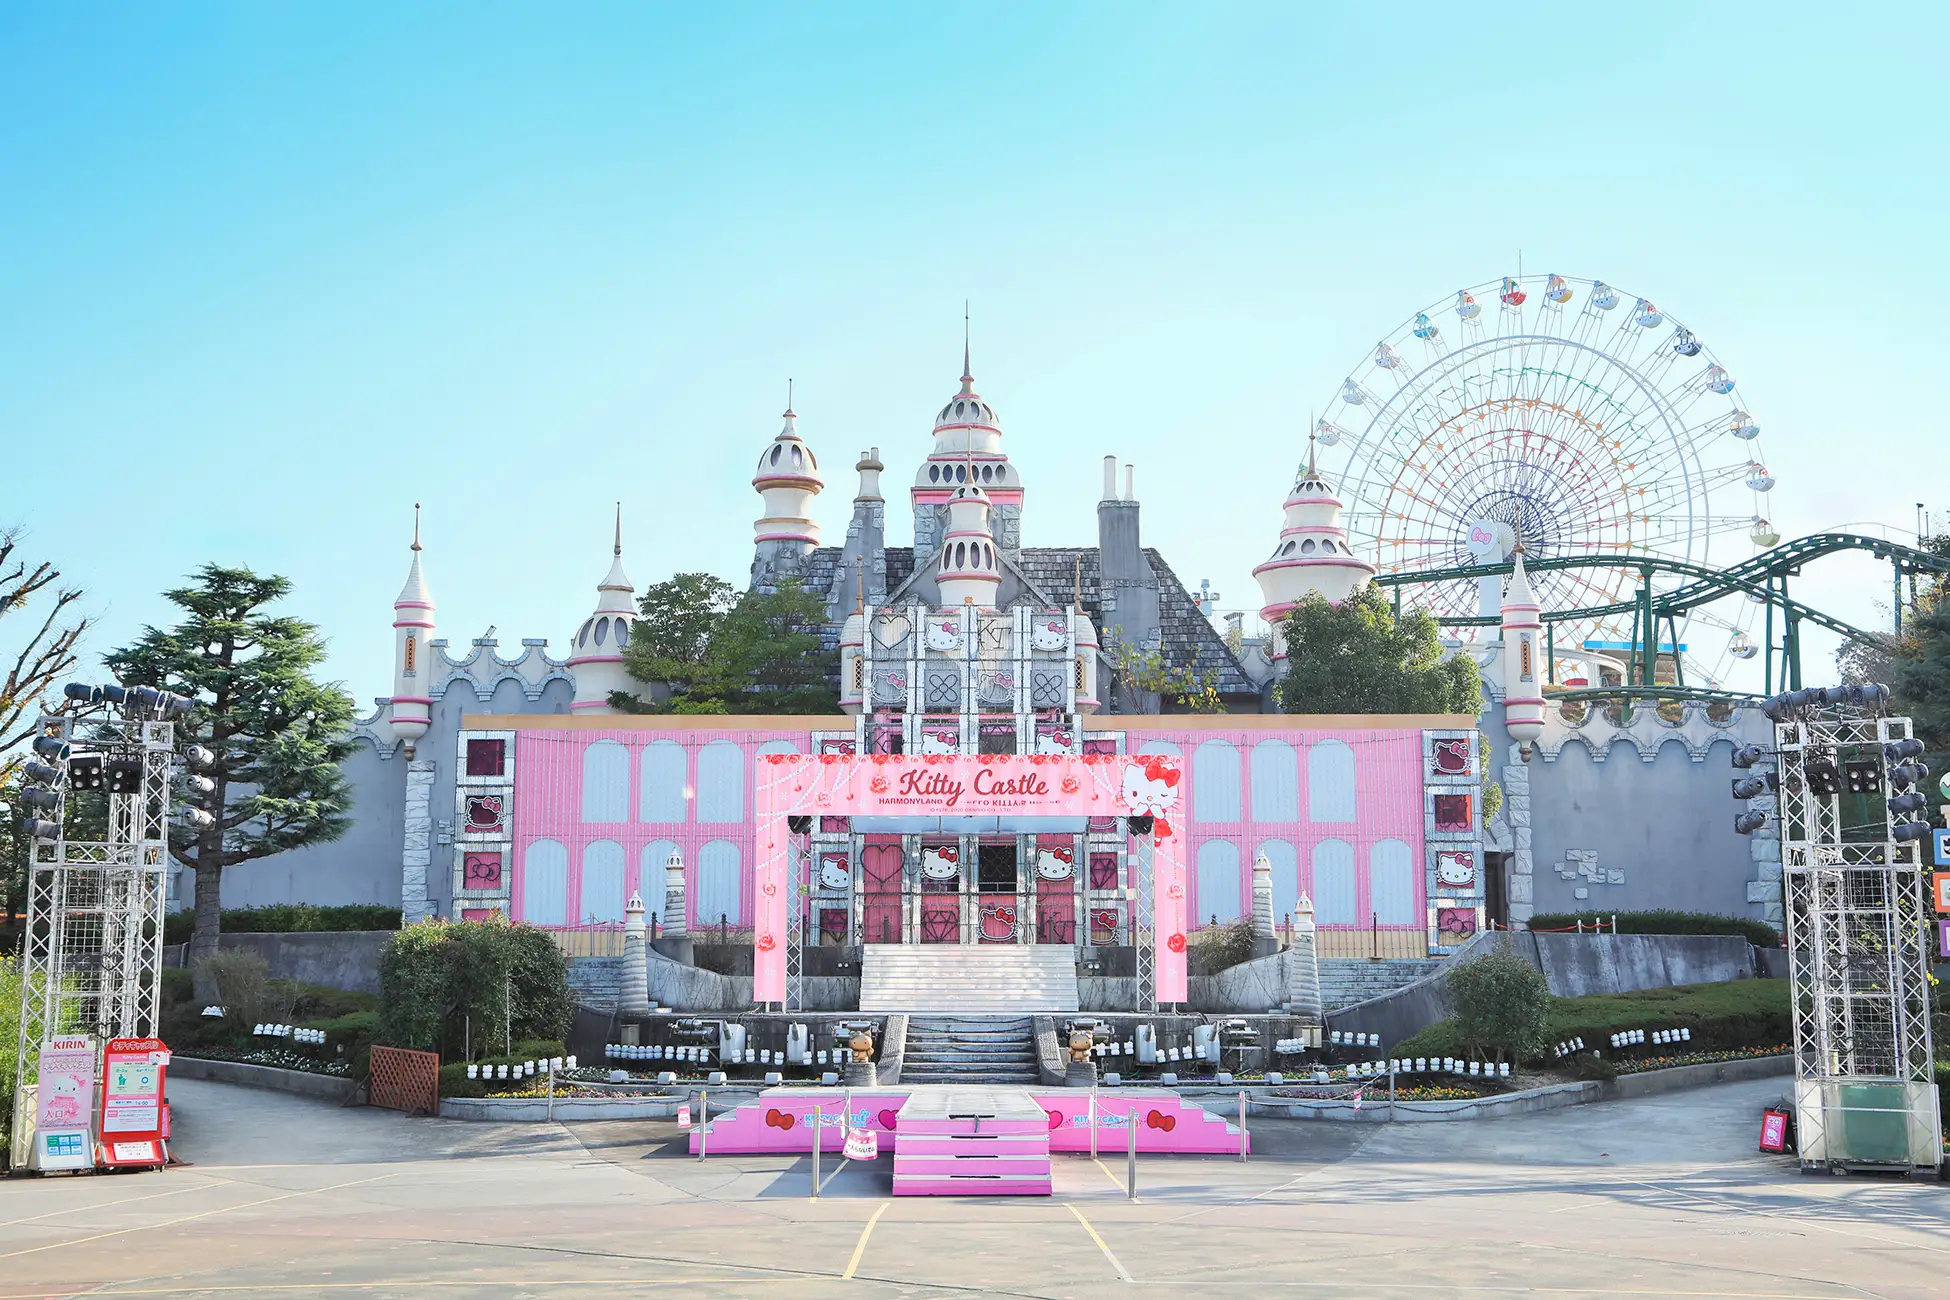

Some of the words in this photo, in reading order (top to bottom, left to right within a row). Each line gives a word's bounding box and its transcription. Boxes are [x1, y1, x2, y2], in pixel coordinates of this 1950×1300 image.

[899, 769, 965, 807] Kitty
[973, 768, 1049, 796] Castle
[53, 1041, 86, 1050] KIRIN
[112, 1040, 159, 1051] キティキャッスル
[44, 1110, 64, 1119] 入口
